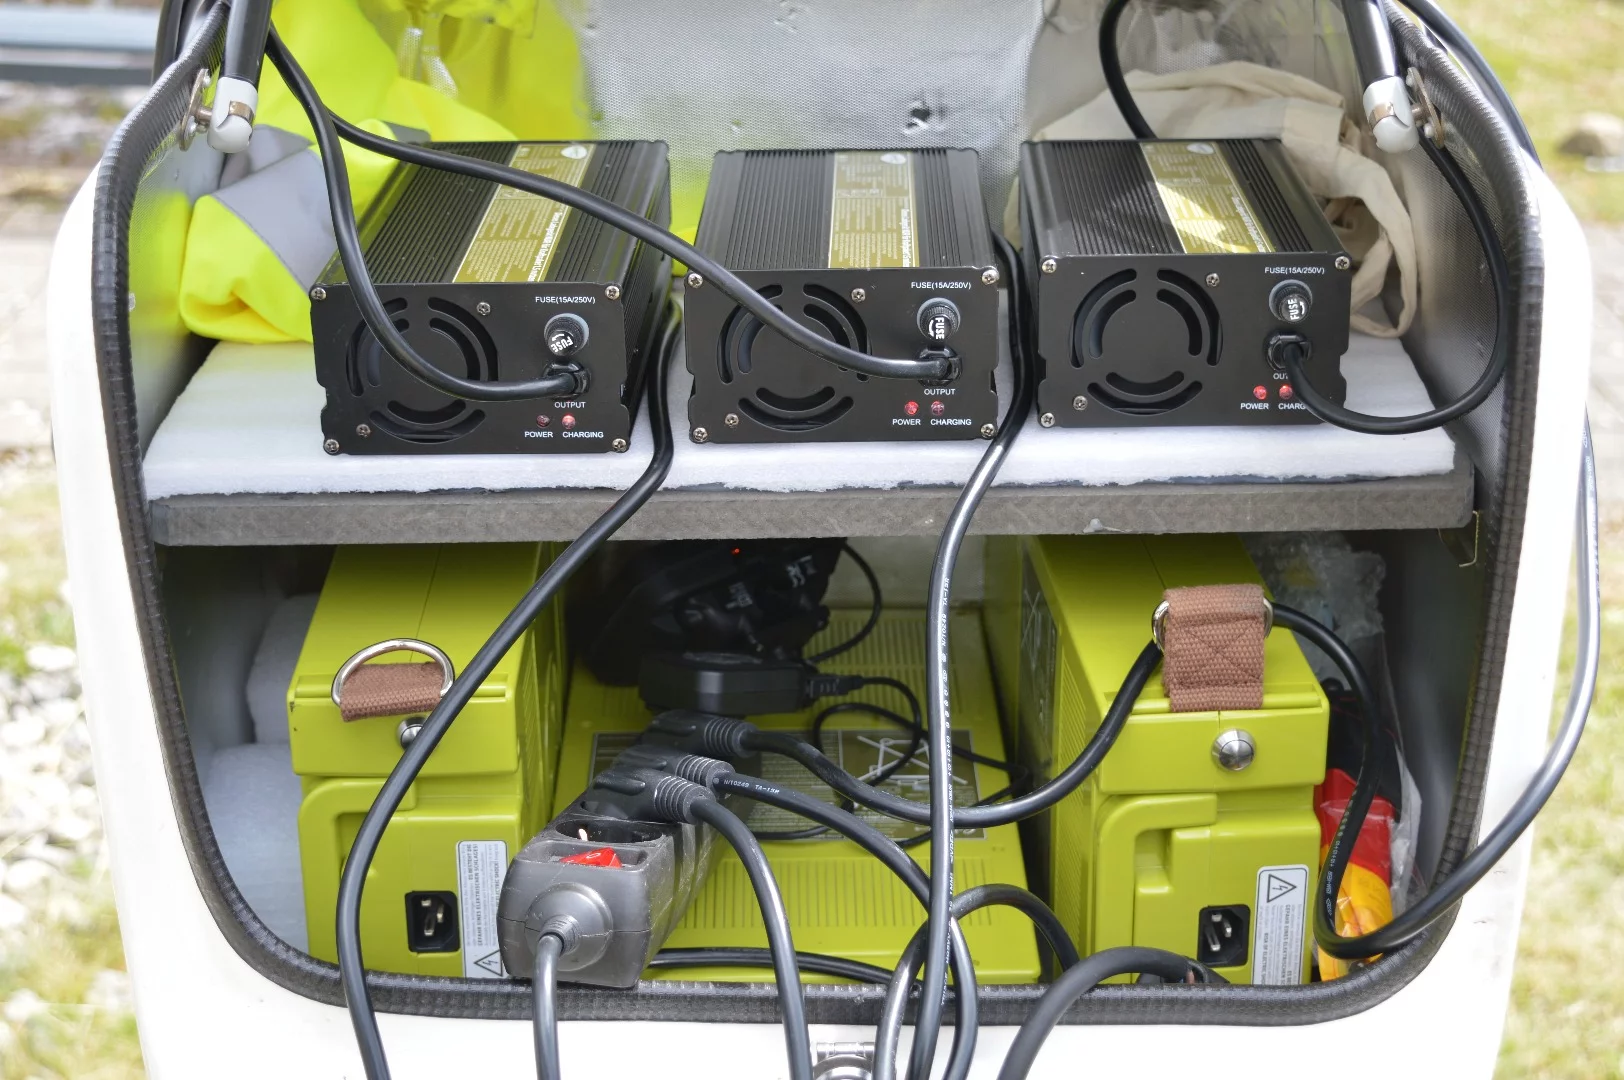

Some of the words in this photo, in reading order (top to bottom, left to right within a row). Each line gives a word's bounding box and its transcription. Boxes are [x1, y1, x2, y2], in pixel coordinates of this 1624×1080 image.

[1264, 267, 1325, 275] FUSE(15A/250V)
[910, 281, 972, 290] FUSE(15A/250V)
[535, 296, 596, 304] FUSE(15A/250V)
[1287, 298, 1300, 320] FUSE
[935, 317, 945, 340] FUSE
[550, 336, 574, 353] FUSE
[923, 388, 956, 396] OUTPUT
[554, 401, 586, 409] OUTPUT
[892, 418, 921, 426] POWER
[930, 418, 972, 426] CHARGING
